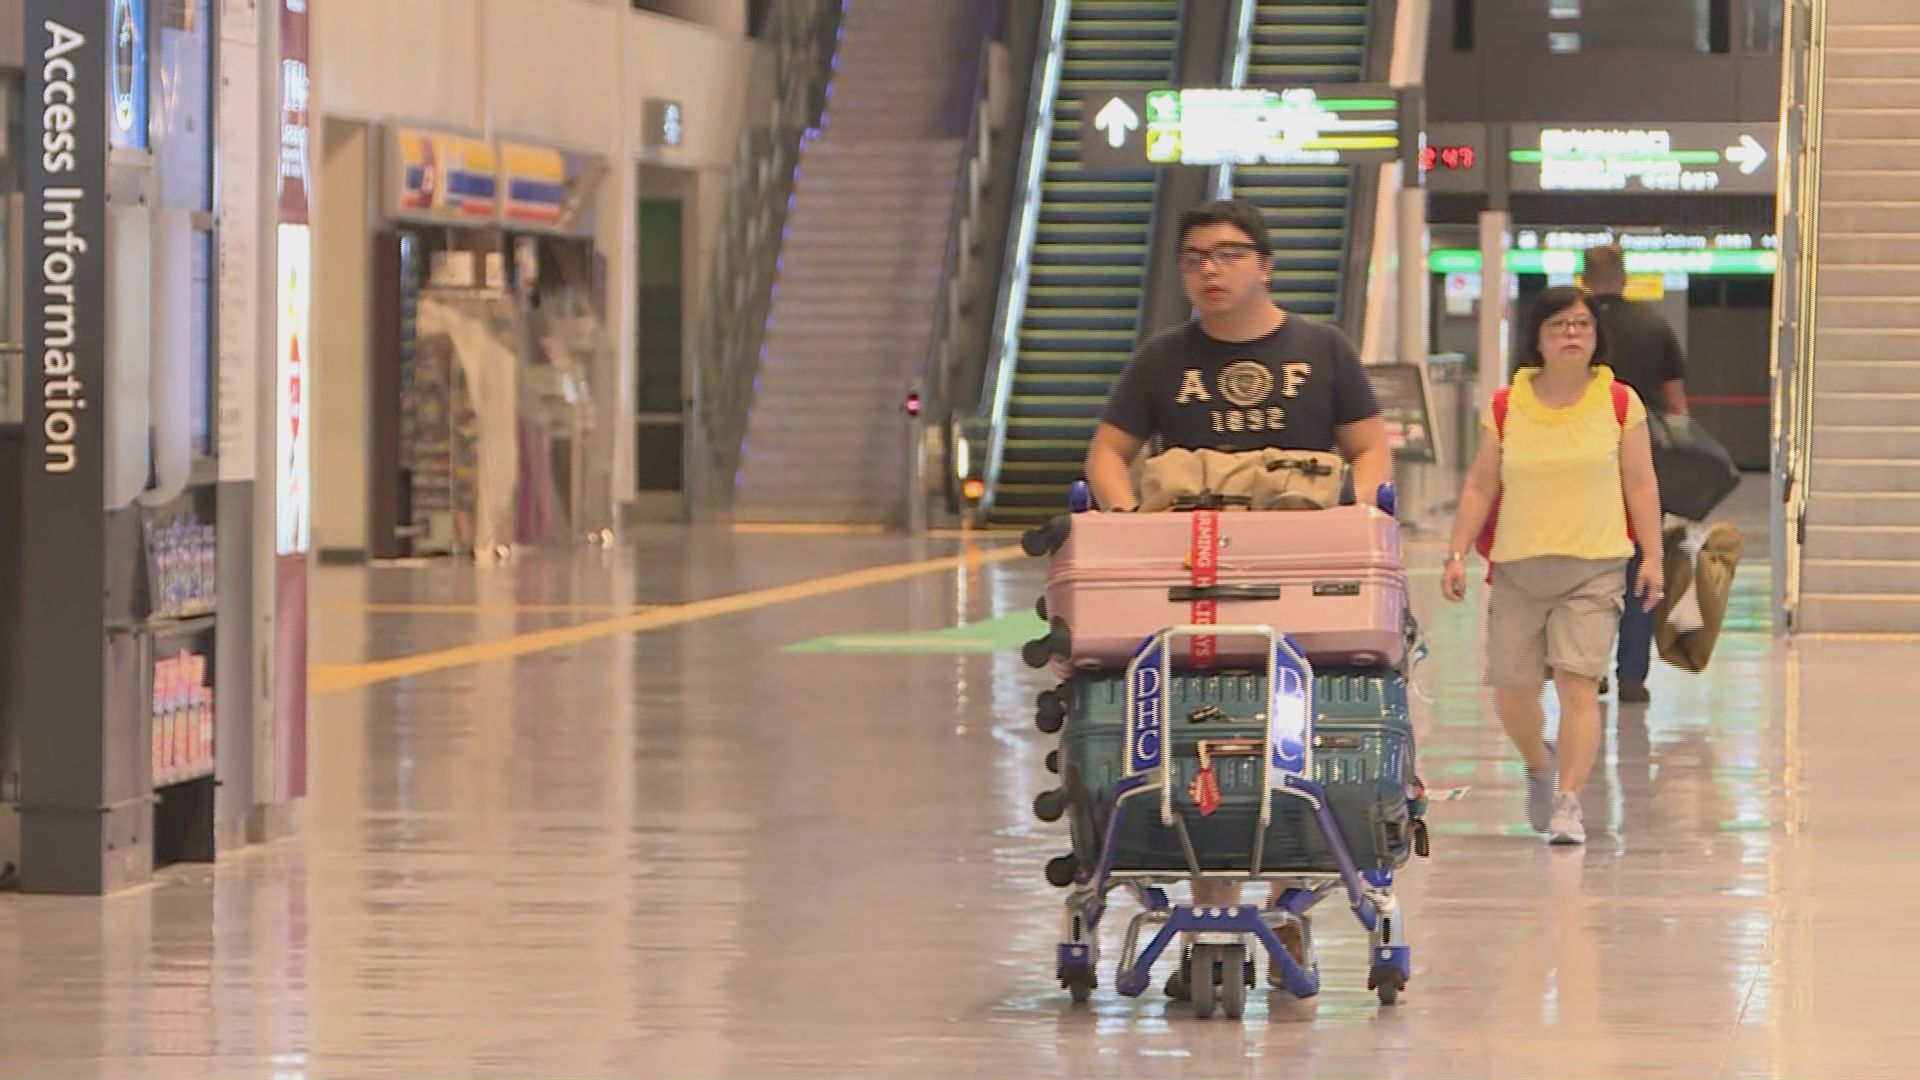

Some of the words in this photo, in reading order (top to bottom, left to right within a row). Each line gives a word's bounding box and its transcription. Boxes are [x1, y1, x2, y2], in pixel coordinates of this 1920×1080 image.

[43, 20, 85, 173] Access
[43, 188, 87, 474] Information
[1176, 368, 1212, 404] A
[1281, 362, 1312, 397] F
[1211, 406, 1286, 432] 1892
[1138, 668, 1160, 761] DHC
[1275, 666, 1303, 762] DC
